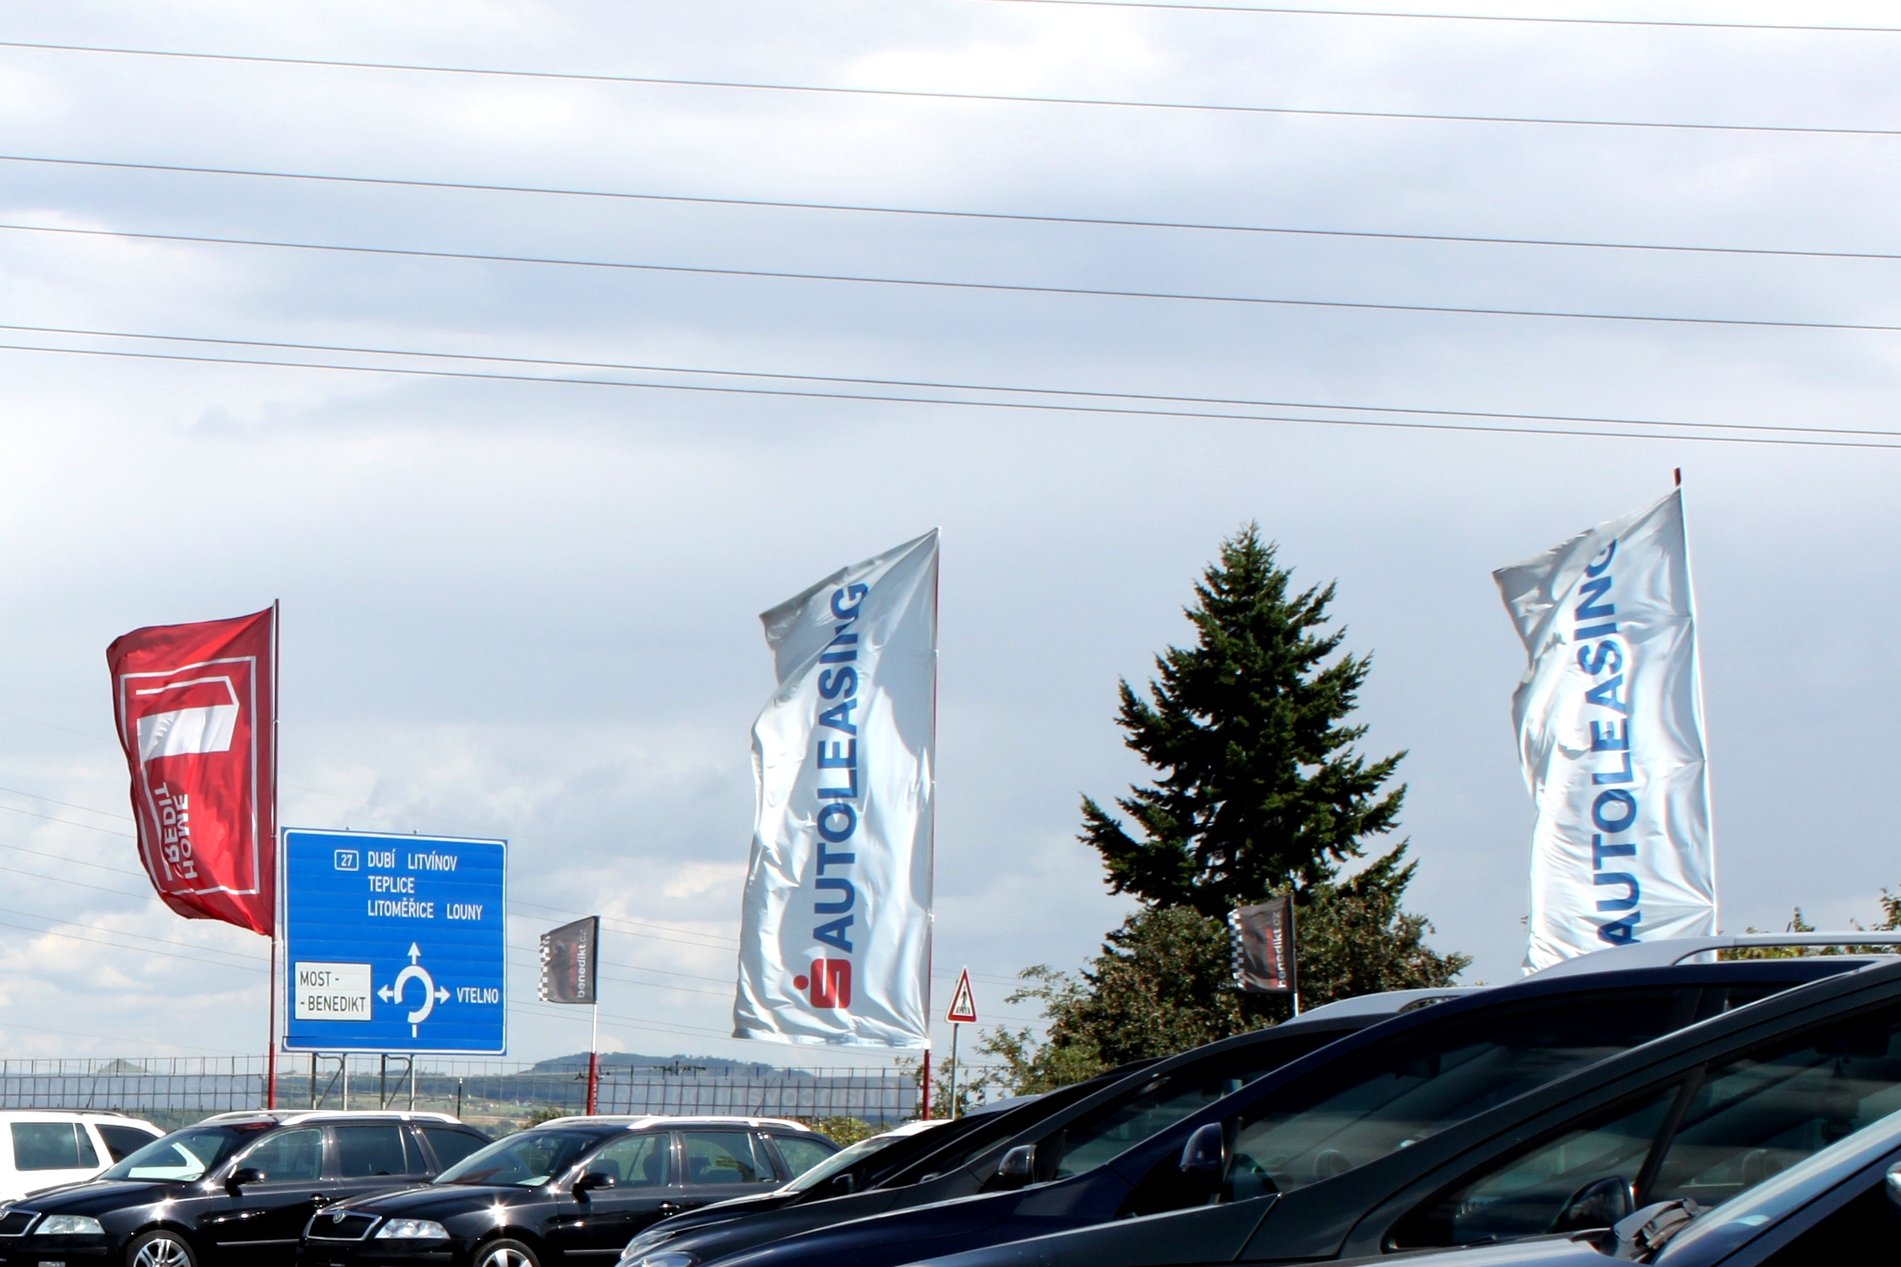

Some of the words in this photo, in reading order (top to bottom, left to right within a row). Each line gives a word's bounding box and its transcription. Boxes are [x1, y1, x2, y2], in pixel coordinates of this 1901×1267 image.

[340, 855, 353, 867] 27
[367, 848, 396, 869] DUBÍ
[408, 850, 458, 872] LITVÍNOV
[368, 876, 415, 894] TEPLICE
[367, 897, 434, 919] LITOMĚŘICE
[446, 904, 483, 921] LOUNY
[456, 987, 499, 1004] VTELNO
